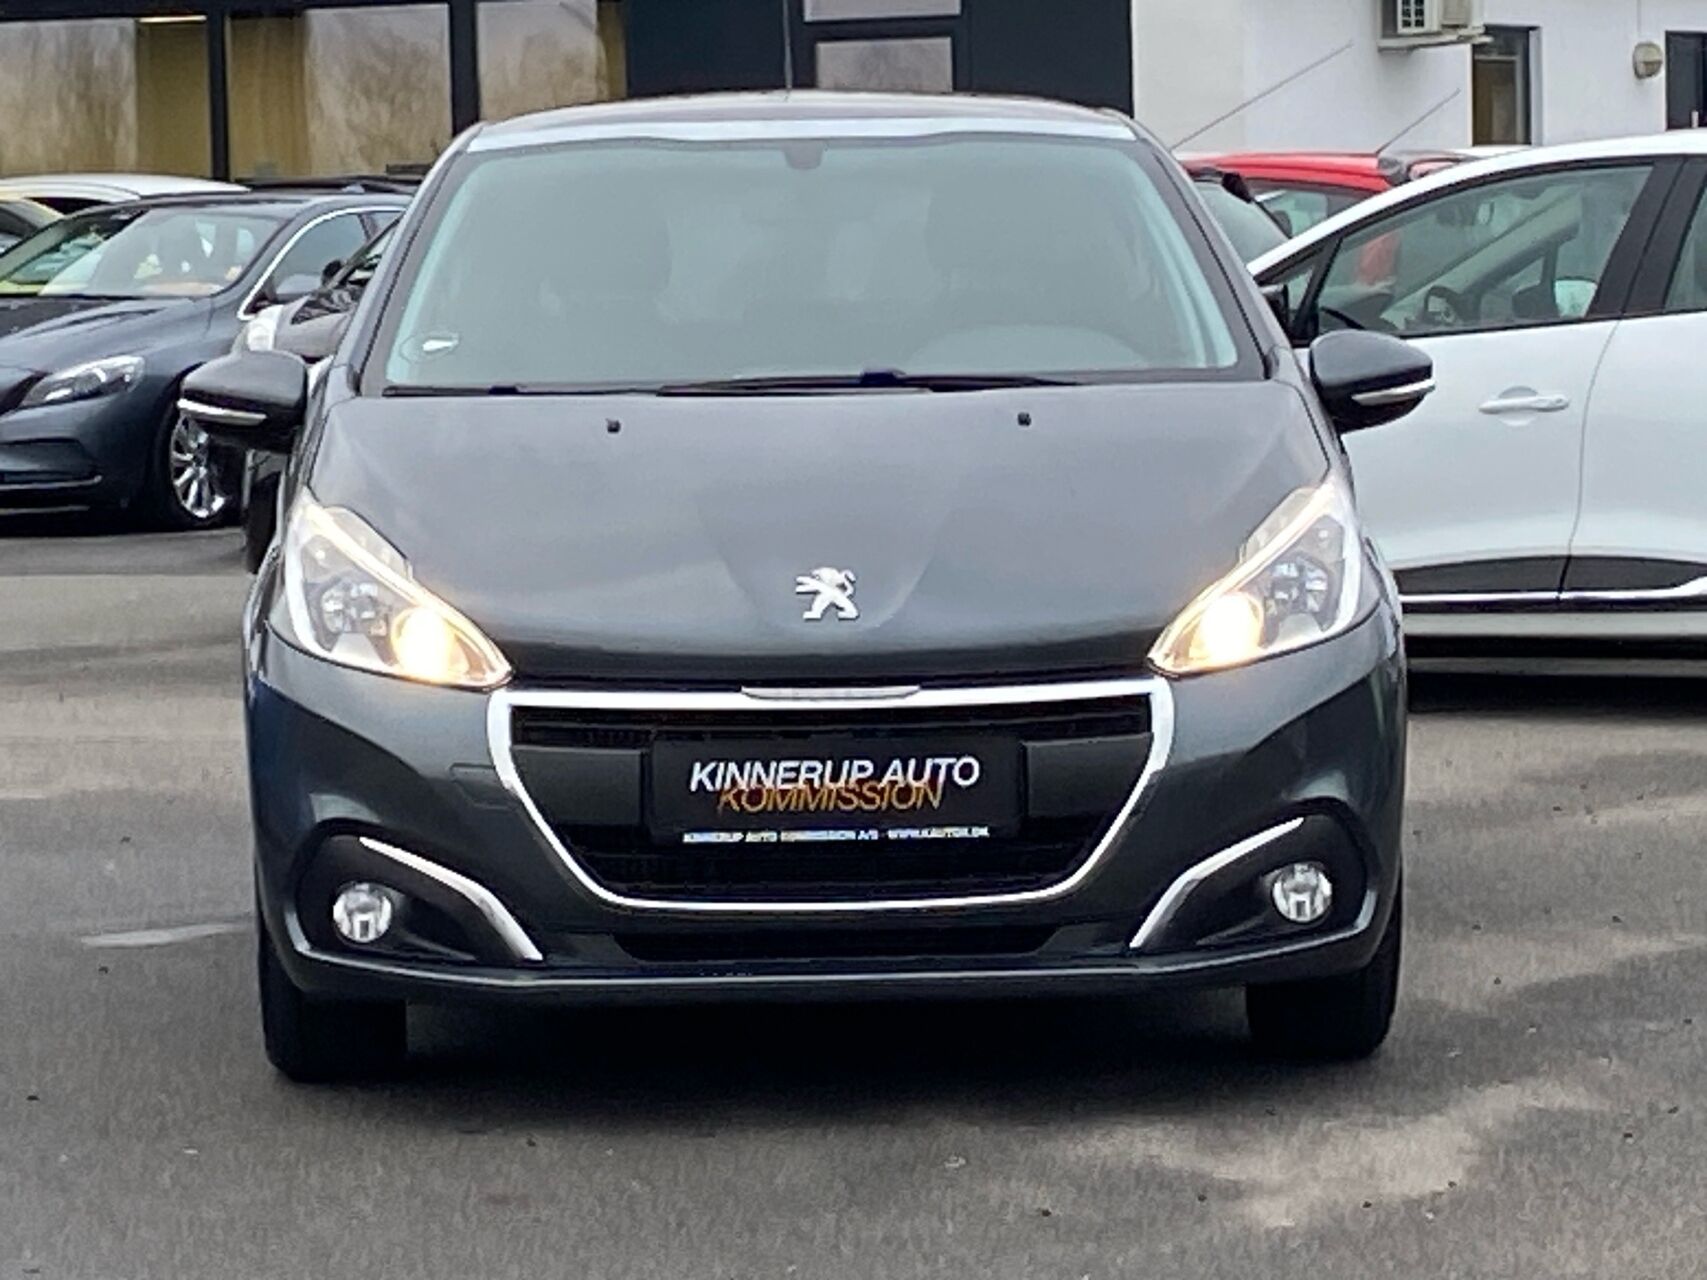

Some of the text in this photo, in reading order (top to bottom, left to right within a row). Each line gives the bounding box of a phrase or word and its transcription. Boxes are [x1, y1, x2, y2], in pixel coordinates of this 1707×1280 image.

[690, 756, 980, 791] KINNERUP AUTO
[717, 779, 944, 814] KOMMISSION
